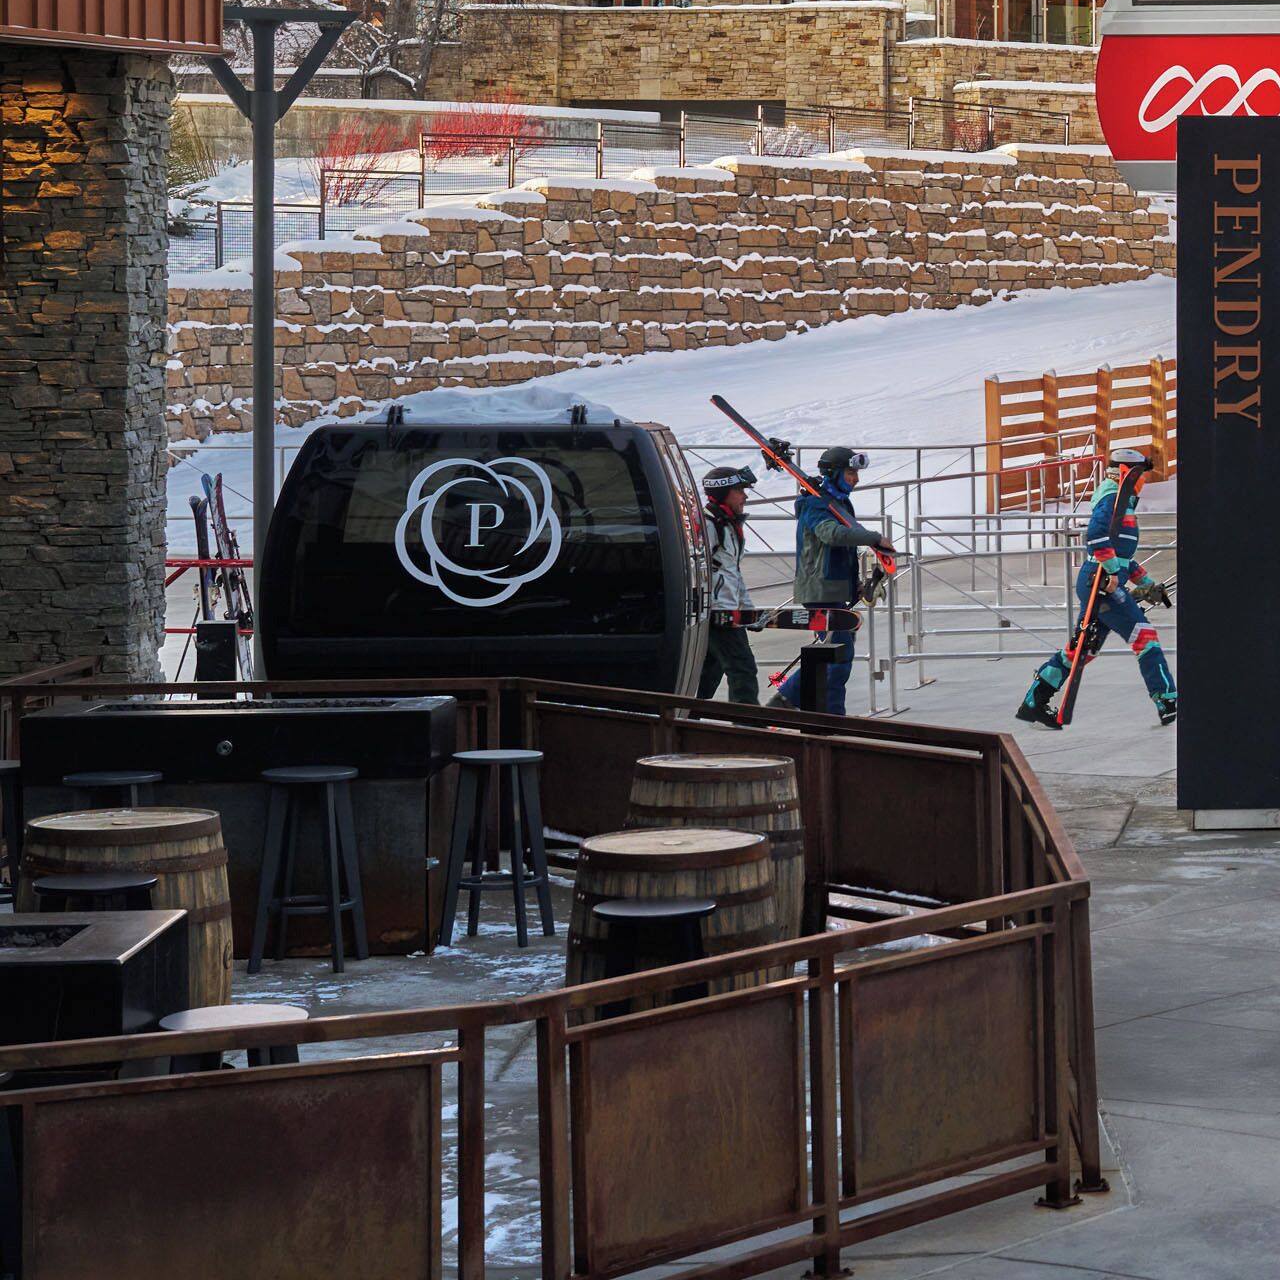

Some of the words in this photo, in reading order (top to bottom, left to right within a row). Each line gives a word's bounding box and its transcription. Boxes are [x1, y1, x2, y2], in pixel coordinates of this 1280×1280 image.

[1214, 153, 1261, 428] PENDRY
[704, 477, 734, 486] GLADE
[464, 503, 505, 547] P
